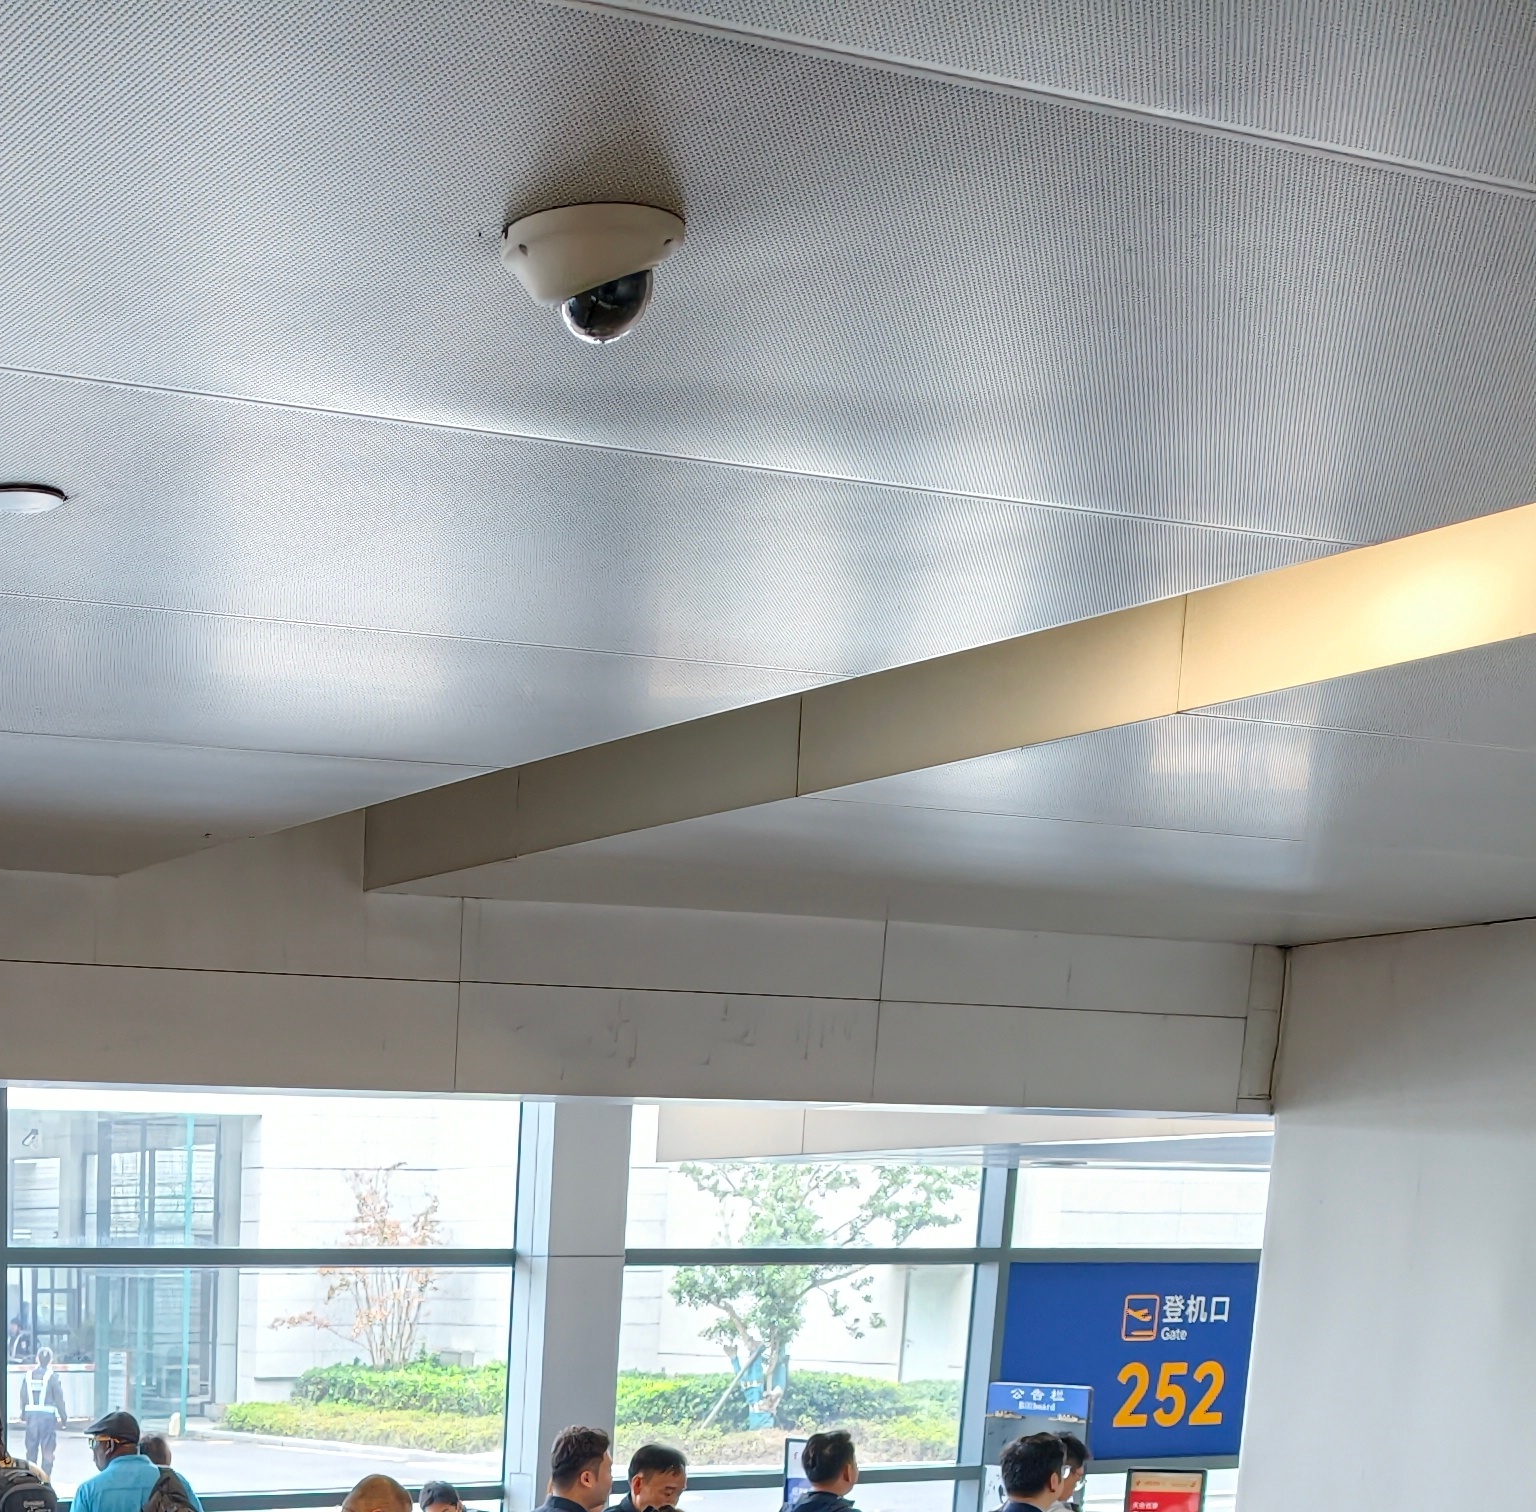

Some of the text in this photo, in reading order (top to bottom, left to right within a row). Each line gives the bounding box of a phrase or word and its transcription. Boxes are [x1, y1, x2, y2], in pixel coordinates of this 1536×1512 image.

[1162, 1294, 1230, 1323] 登机口
[1160, 1327, 1188, 1341] Gate
[1113, 1360, 1225, 1428] 252
